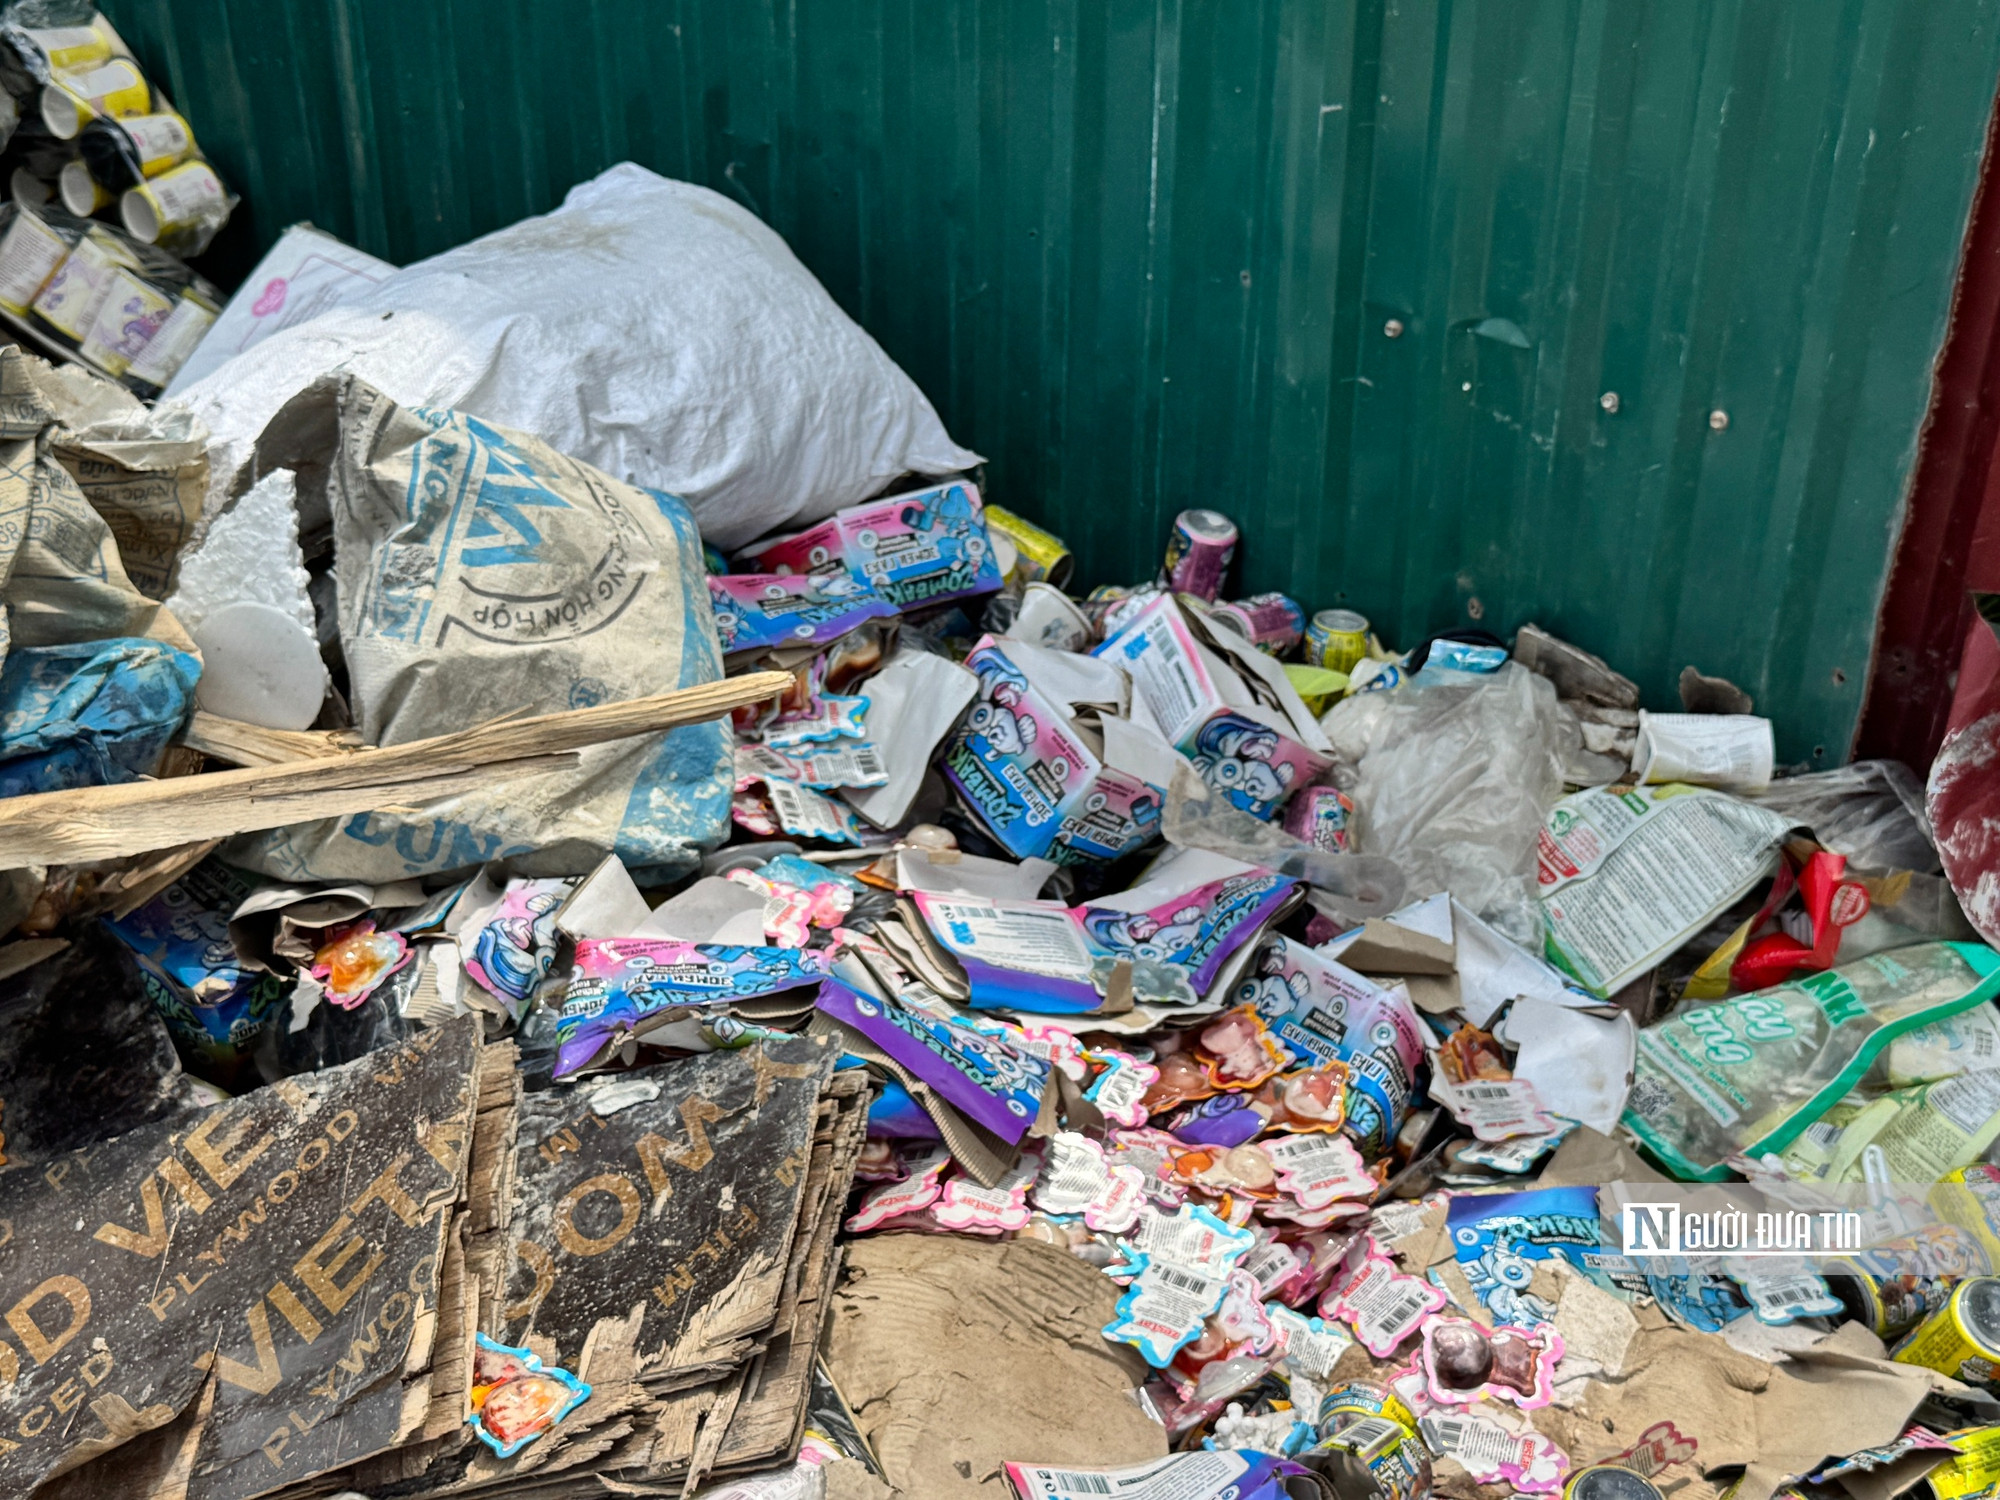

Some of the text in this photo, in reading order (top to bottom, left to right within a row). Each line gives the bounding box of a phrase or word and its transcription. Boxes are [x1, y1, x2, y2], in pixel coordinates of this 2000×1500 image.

[147, 1108, 360, 1322] PLYWOOD
[958, 1196, 1003, 1215] zestar
[650, 1201, 760, 1308] FILM
[1136, 1318, 1179, 1339] zestar
